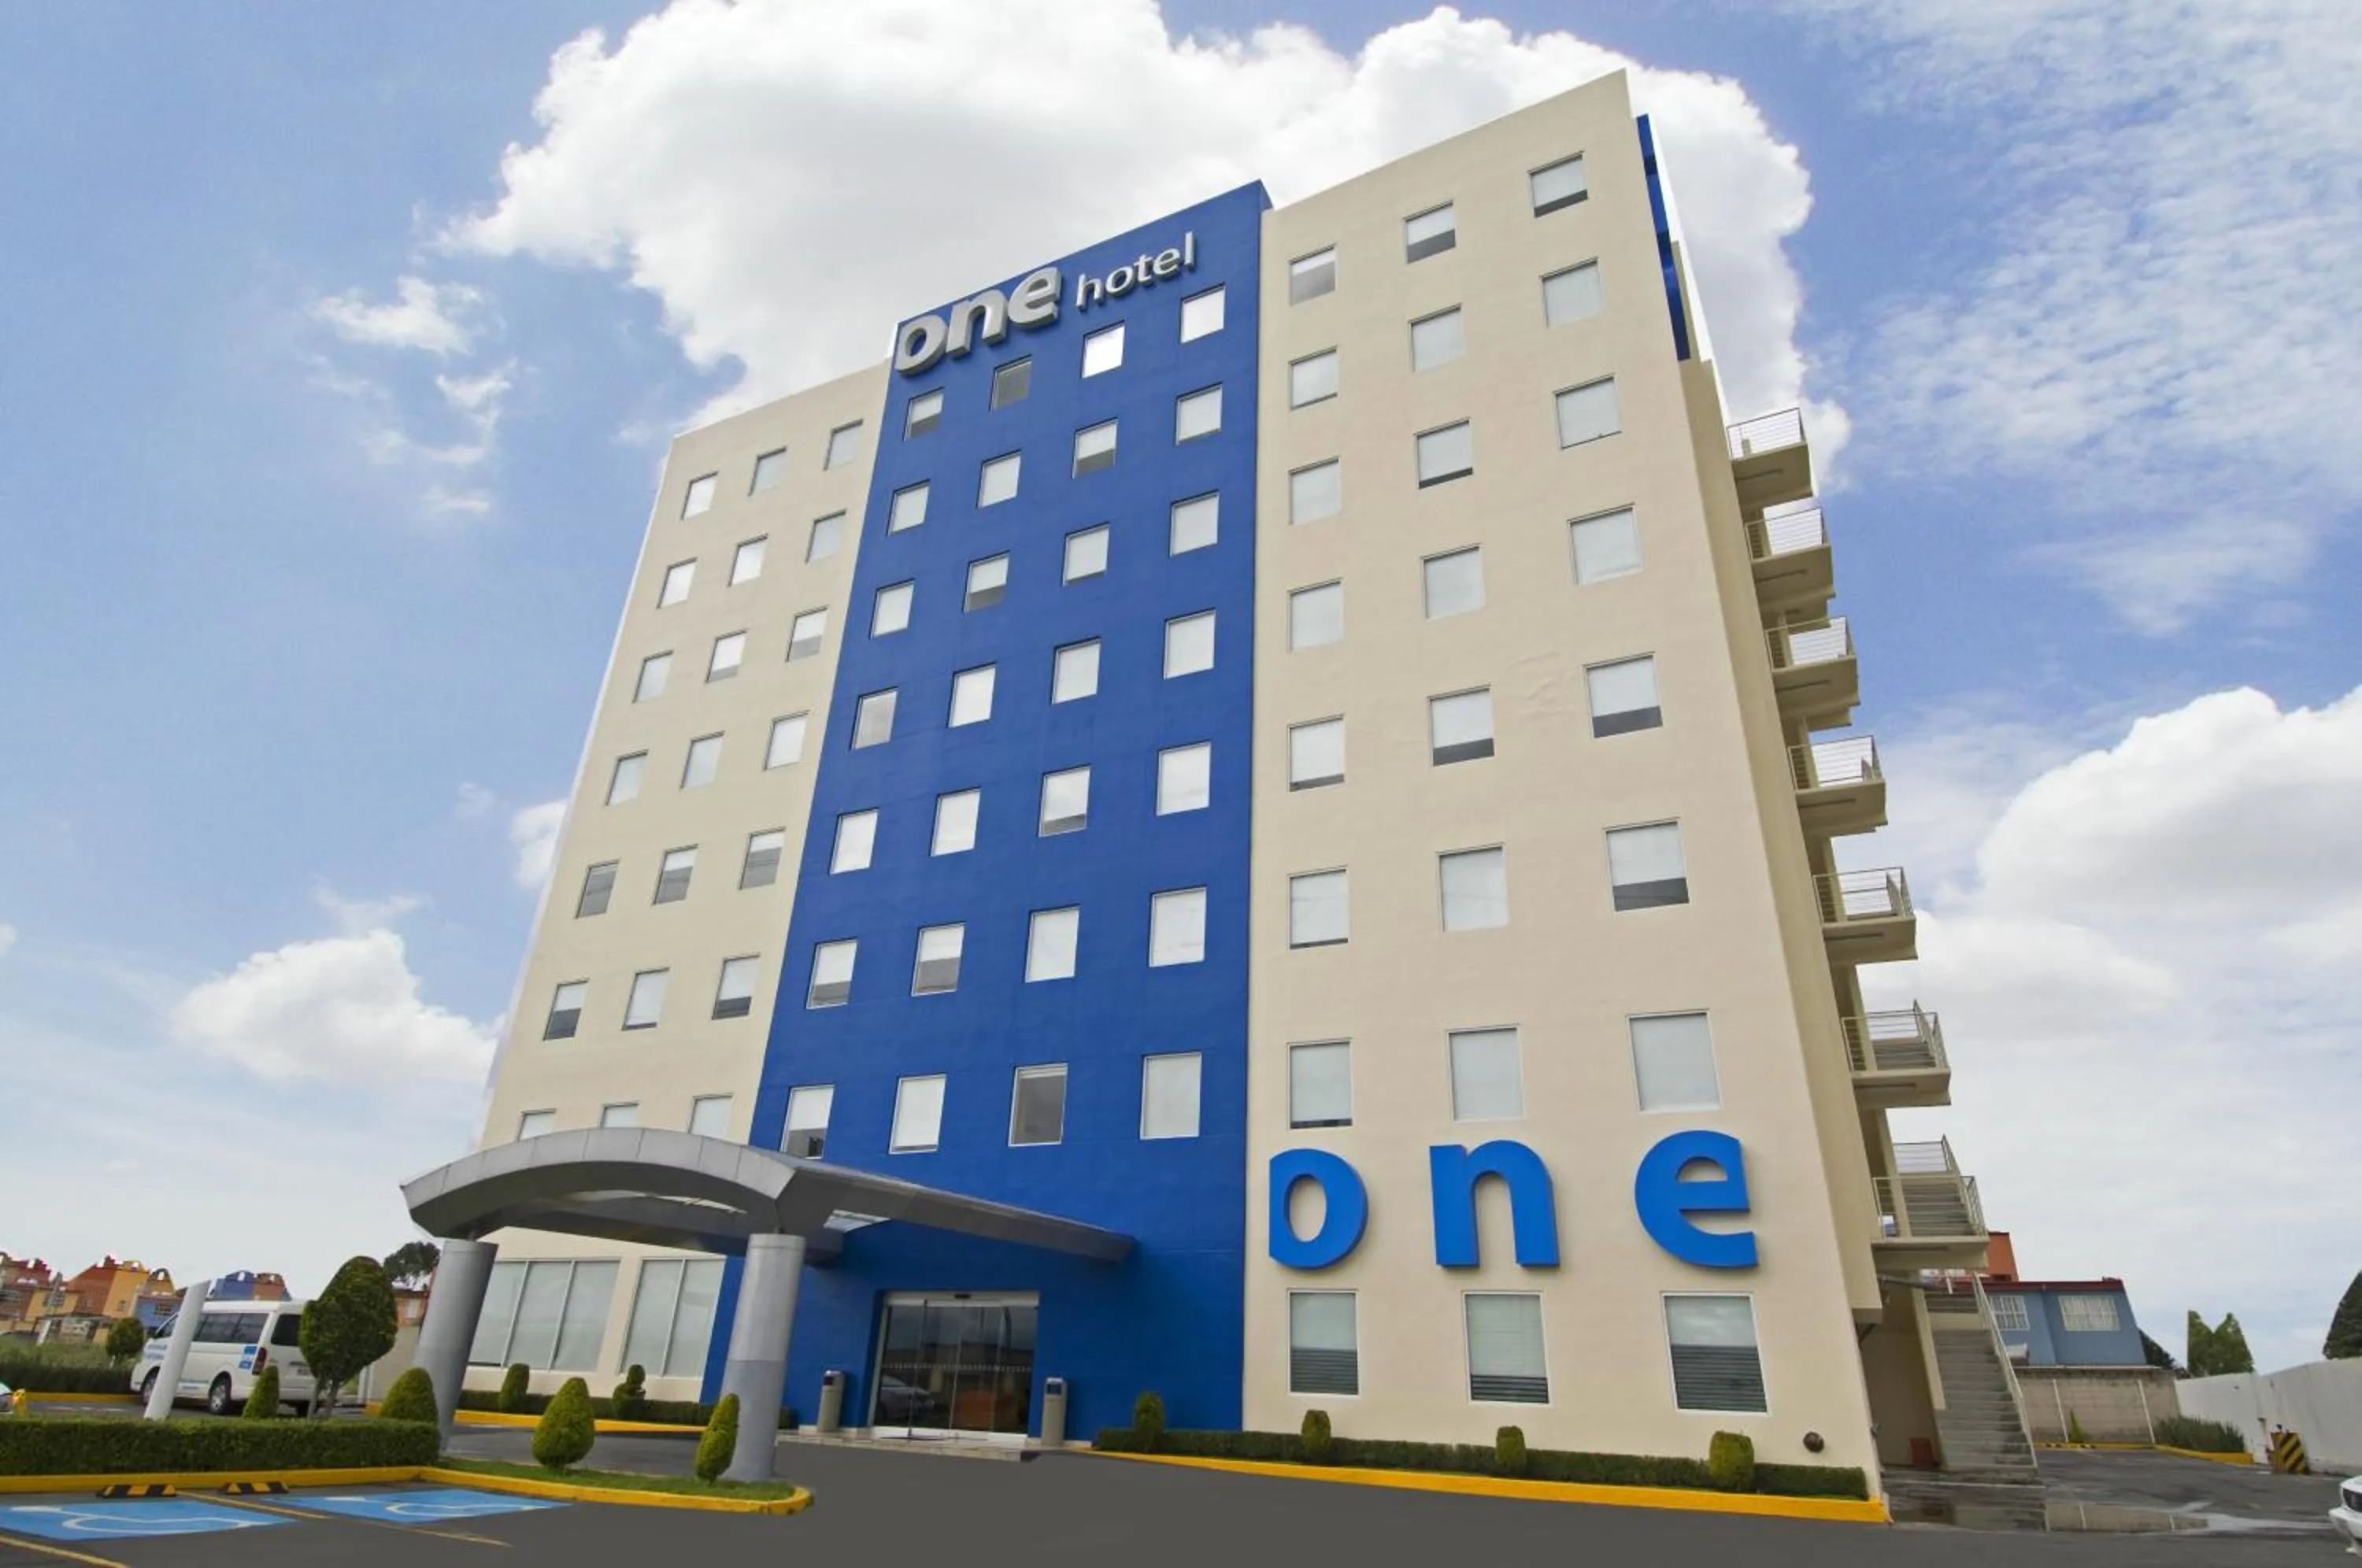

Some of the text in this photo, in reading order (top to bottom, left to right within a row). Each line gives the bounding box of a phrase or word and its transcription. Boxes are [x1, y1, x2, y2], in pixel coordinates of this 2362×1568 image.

[894, 231, 1196, 376] one hotel
[1269, 1130, 1759, 1270] one
